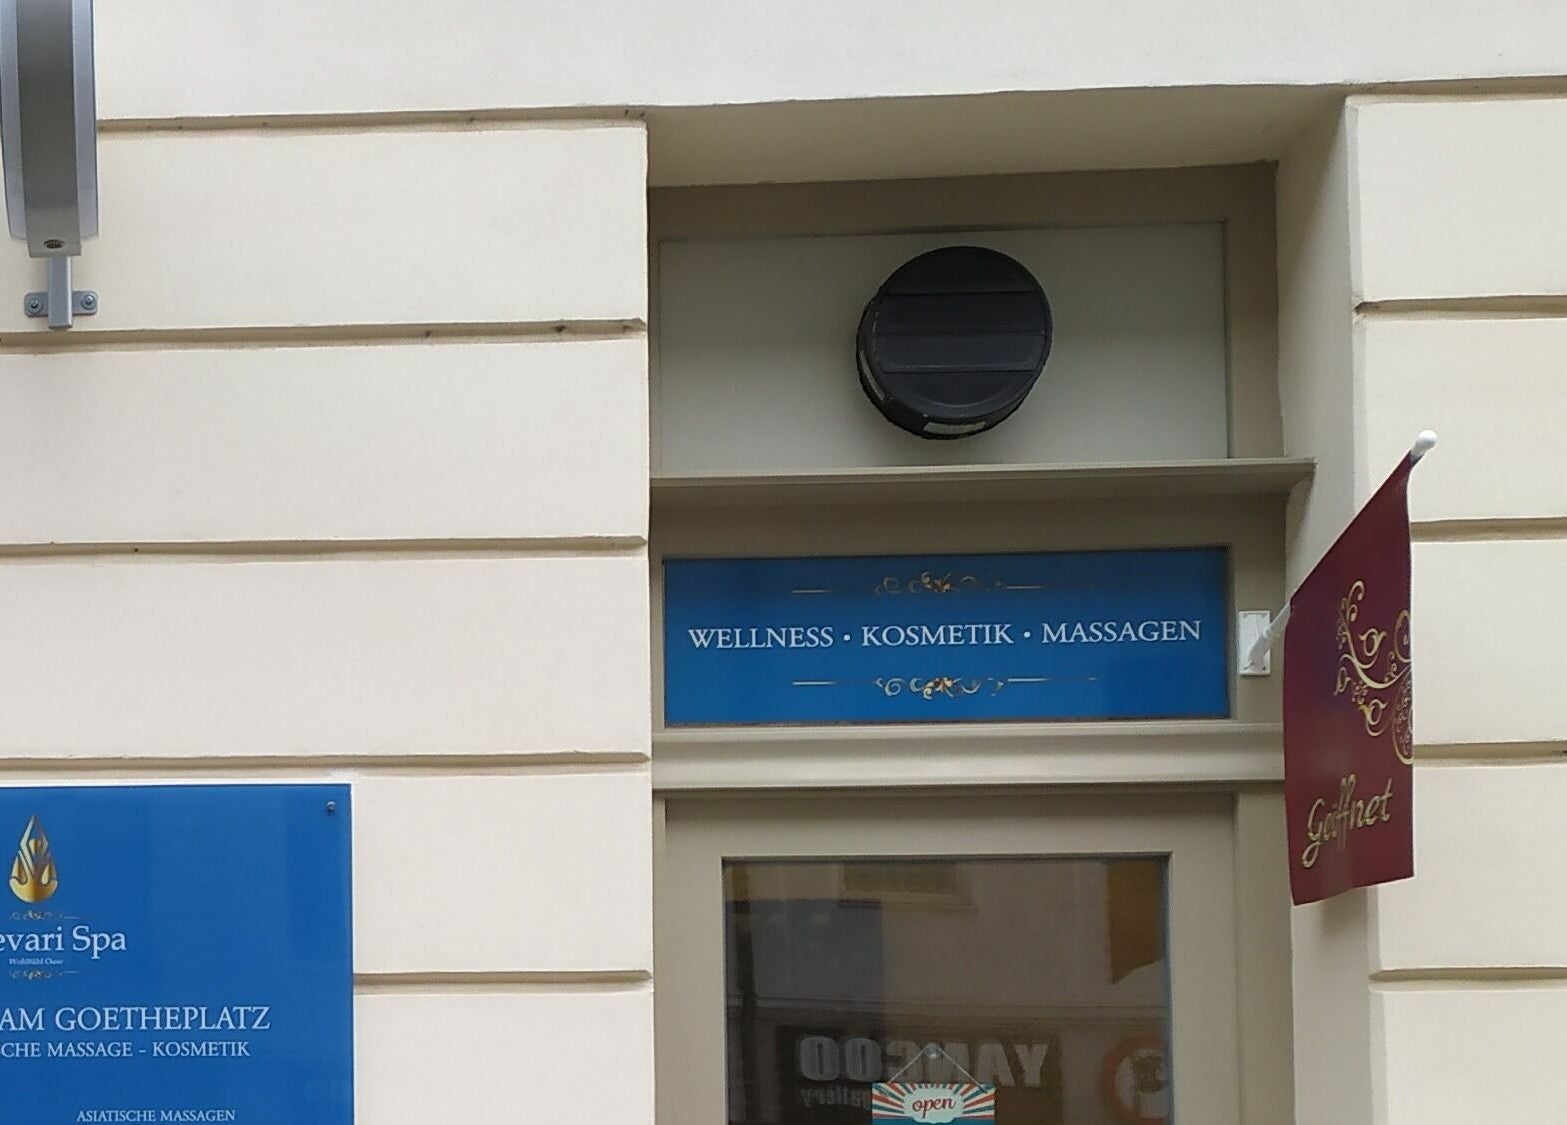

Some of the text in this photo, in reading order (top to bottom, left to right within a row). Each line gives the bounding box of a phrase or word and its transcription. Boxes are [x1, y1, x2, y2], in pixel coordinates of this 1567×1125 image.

[688, 621, 1200, 648] WELLNESS KOSMETIK MASSAGEN
[73, 926, 126, 959] Spa
[55, 1007, 270, 1030] GOETHEPLATZ
[48, 1042, 132, 1057] MASSAGE
[153, 1042, 250, 1056] KOSMETIK
[77, 1110, 235, 1121] ASIATISCHE MASSAGEN
[911, 1095, 957, 1116] open
